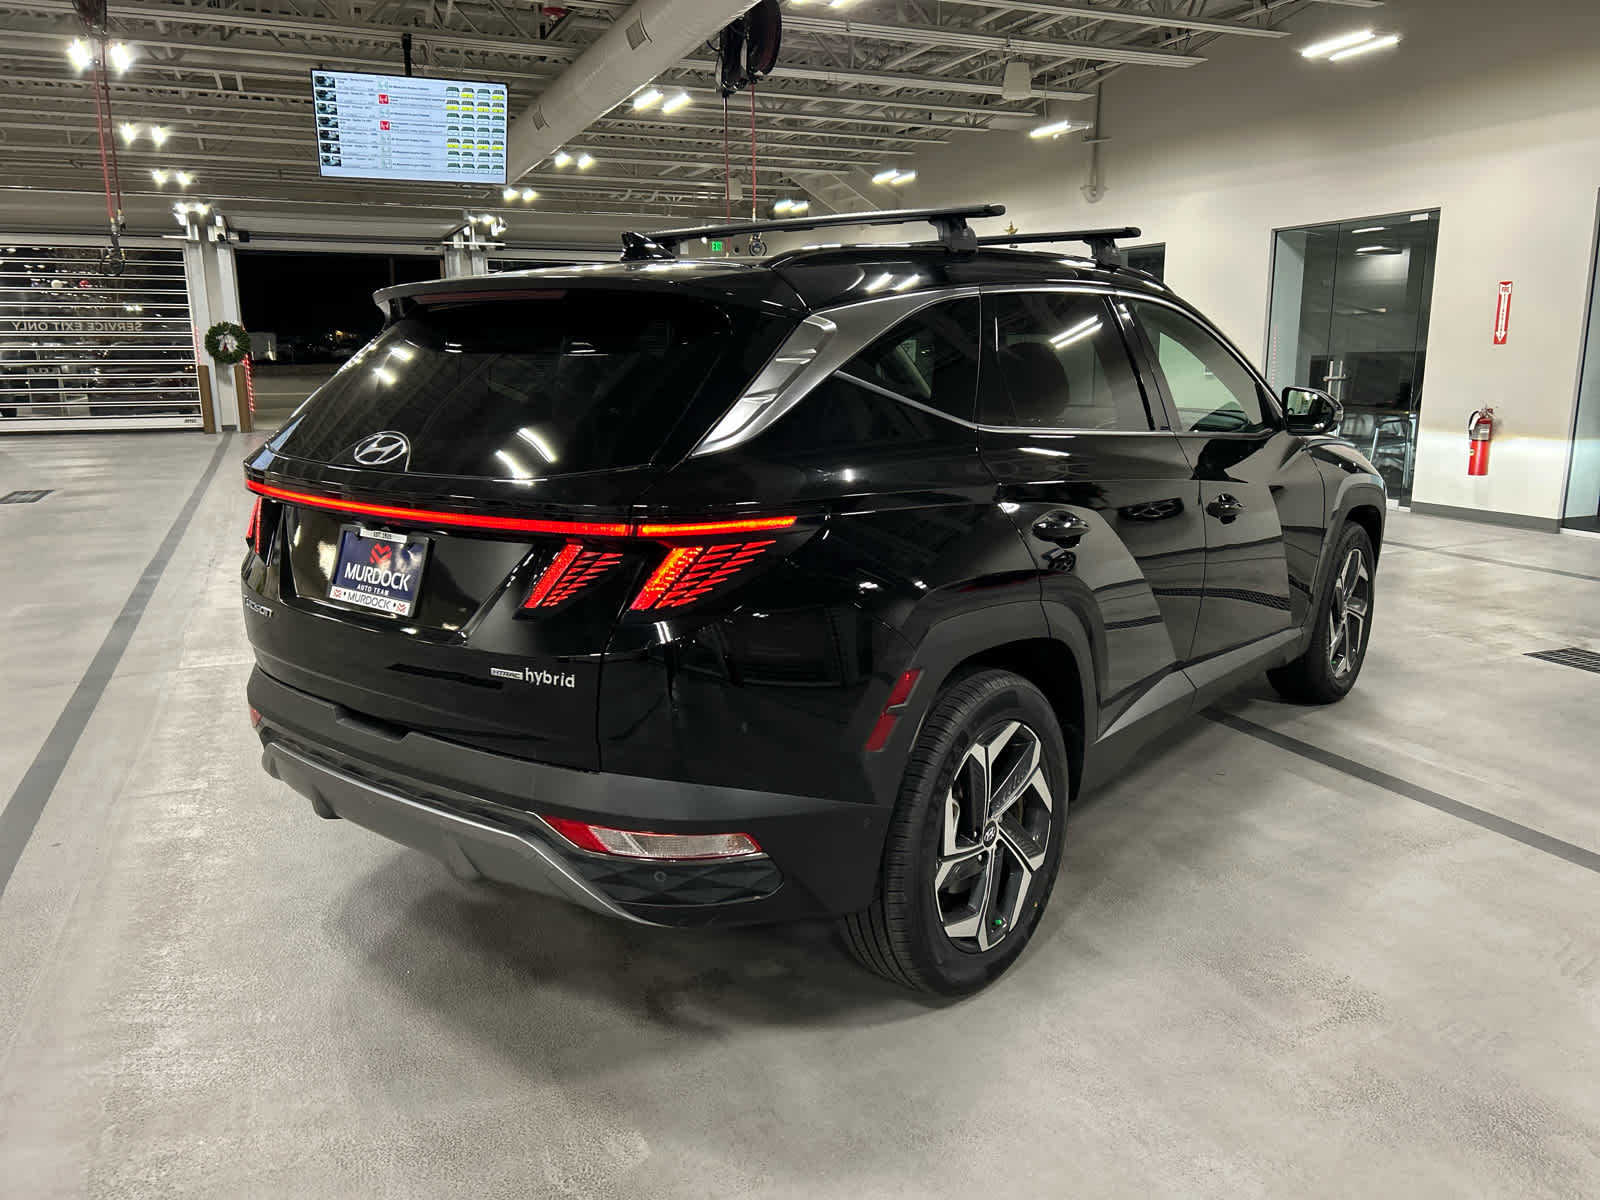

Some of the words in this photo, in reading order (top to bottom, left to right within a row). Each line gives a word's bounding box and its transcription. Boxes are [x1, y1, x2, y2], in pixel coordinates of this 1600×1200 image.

[344, 562, 411, 591] MURDOCK
[356, 584, 372, 593] AUTO
[373, 587, 390, 596] TEAM
[347, 591, 391, 610] MURDOCK
[525, 667, 575, 688] hybrid
